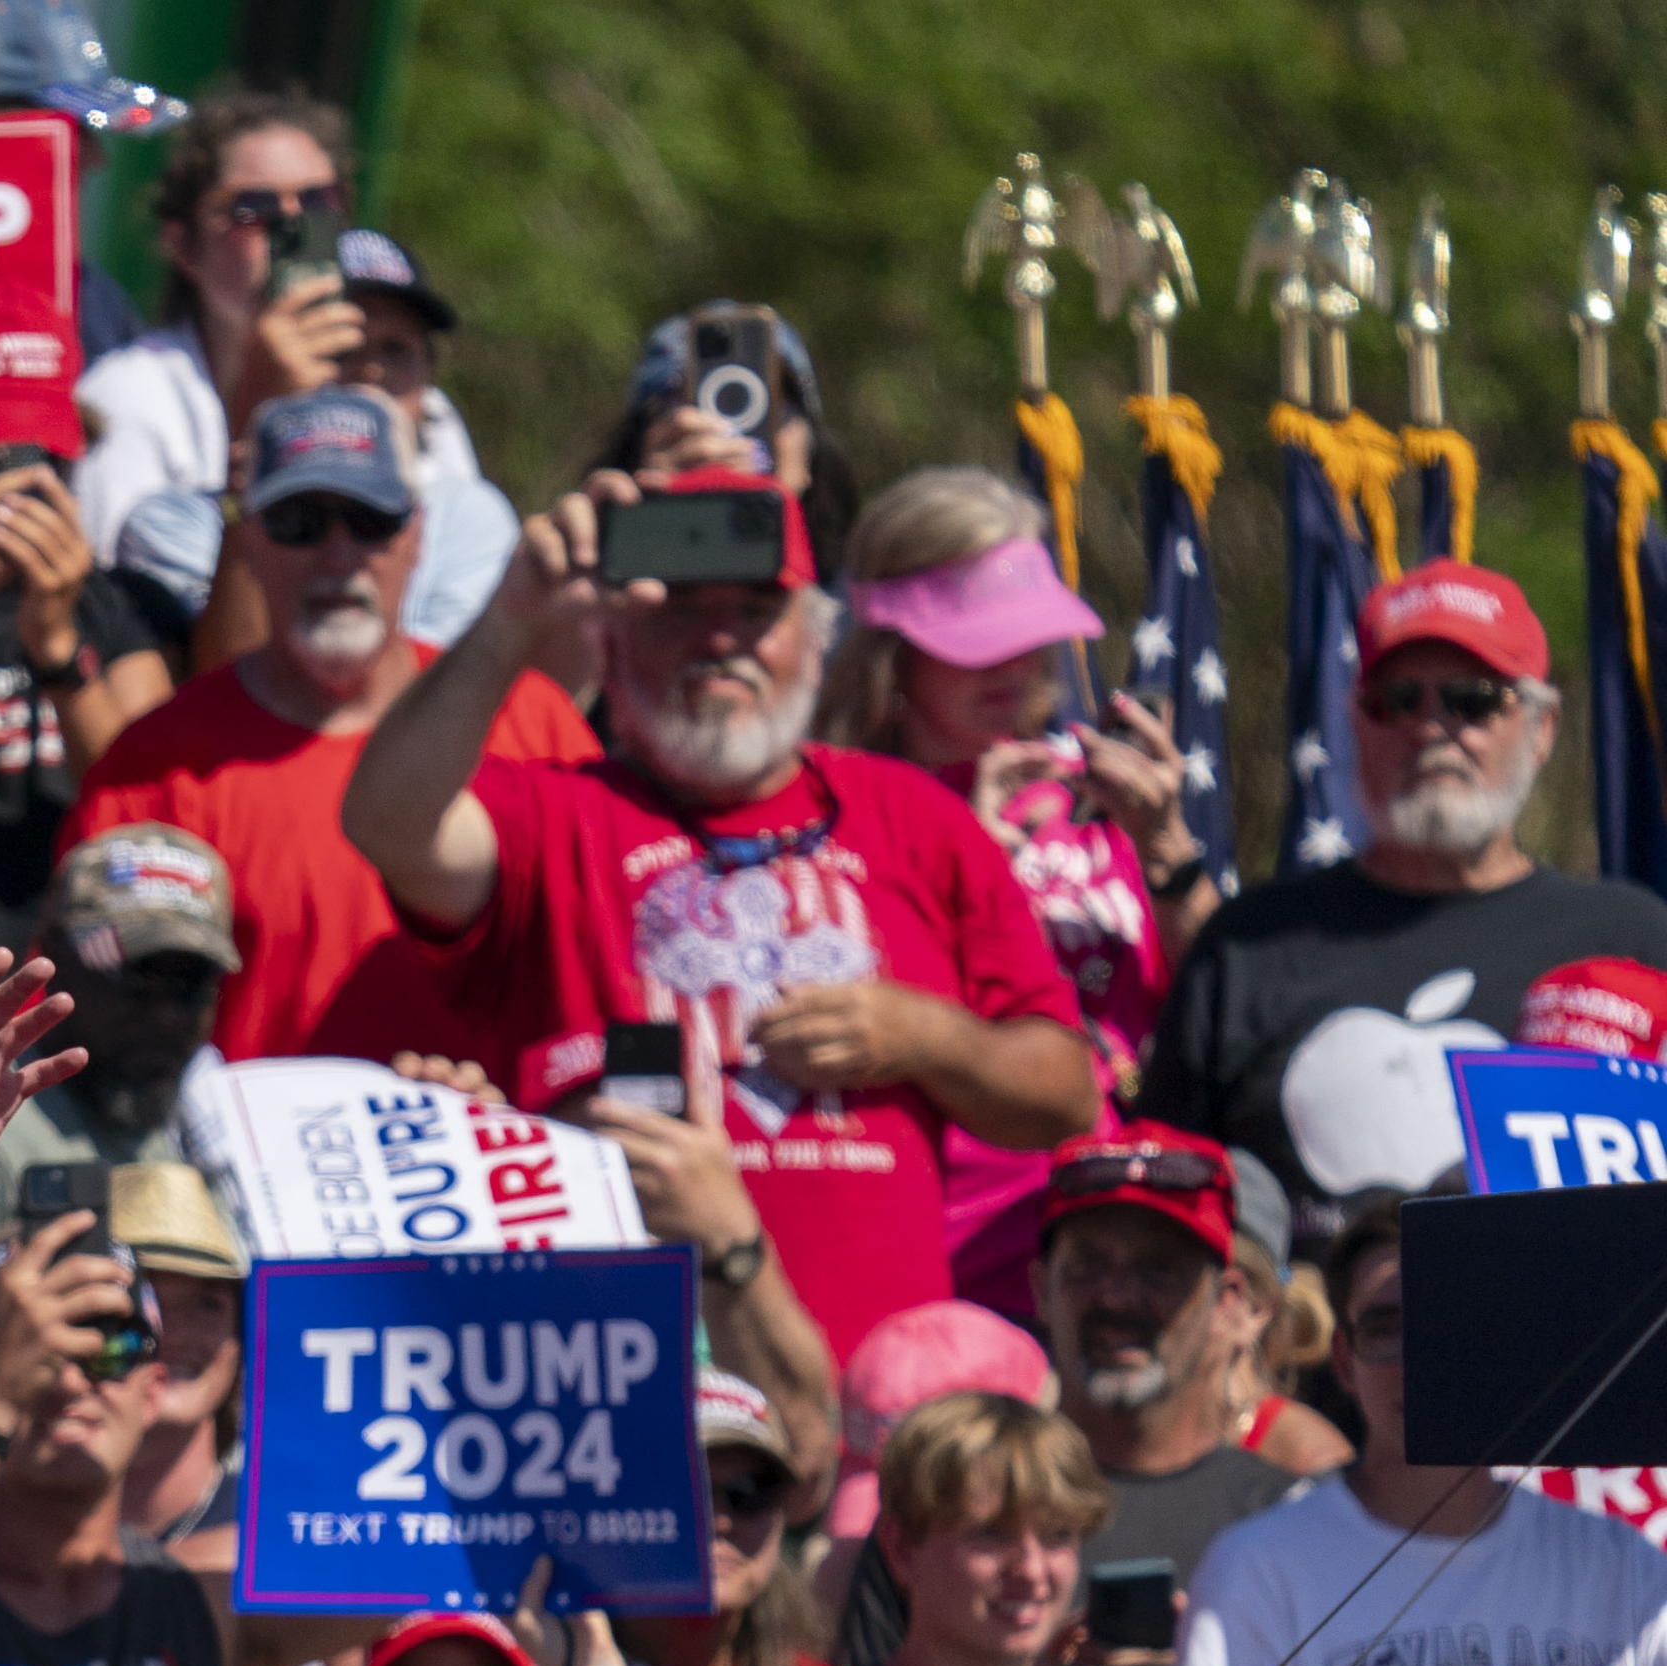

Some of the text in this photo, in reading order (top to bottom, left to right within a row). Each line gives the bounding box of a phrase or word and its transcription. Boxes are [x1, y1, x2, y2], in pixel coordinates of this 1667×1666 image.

[466, 1102, 570, 1250] IRE
[300, 1317, 660, 1413] TRUMP
[356, 1408, 623, 1501] 2024
[287, 1507, 679, 1546] TEXT TRUMP TO 88022
